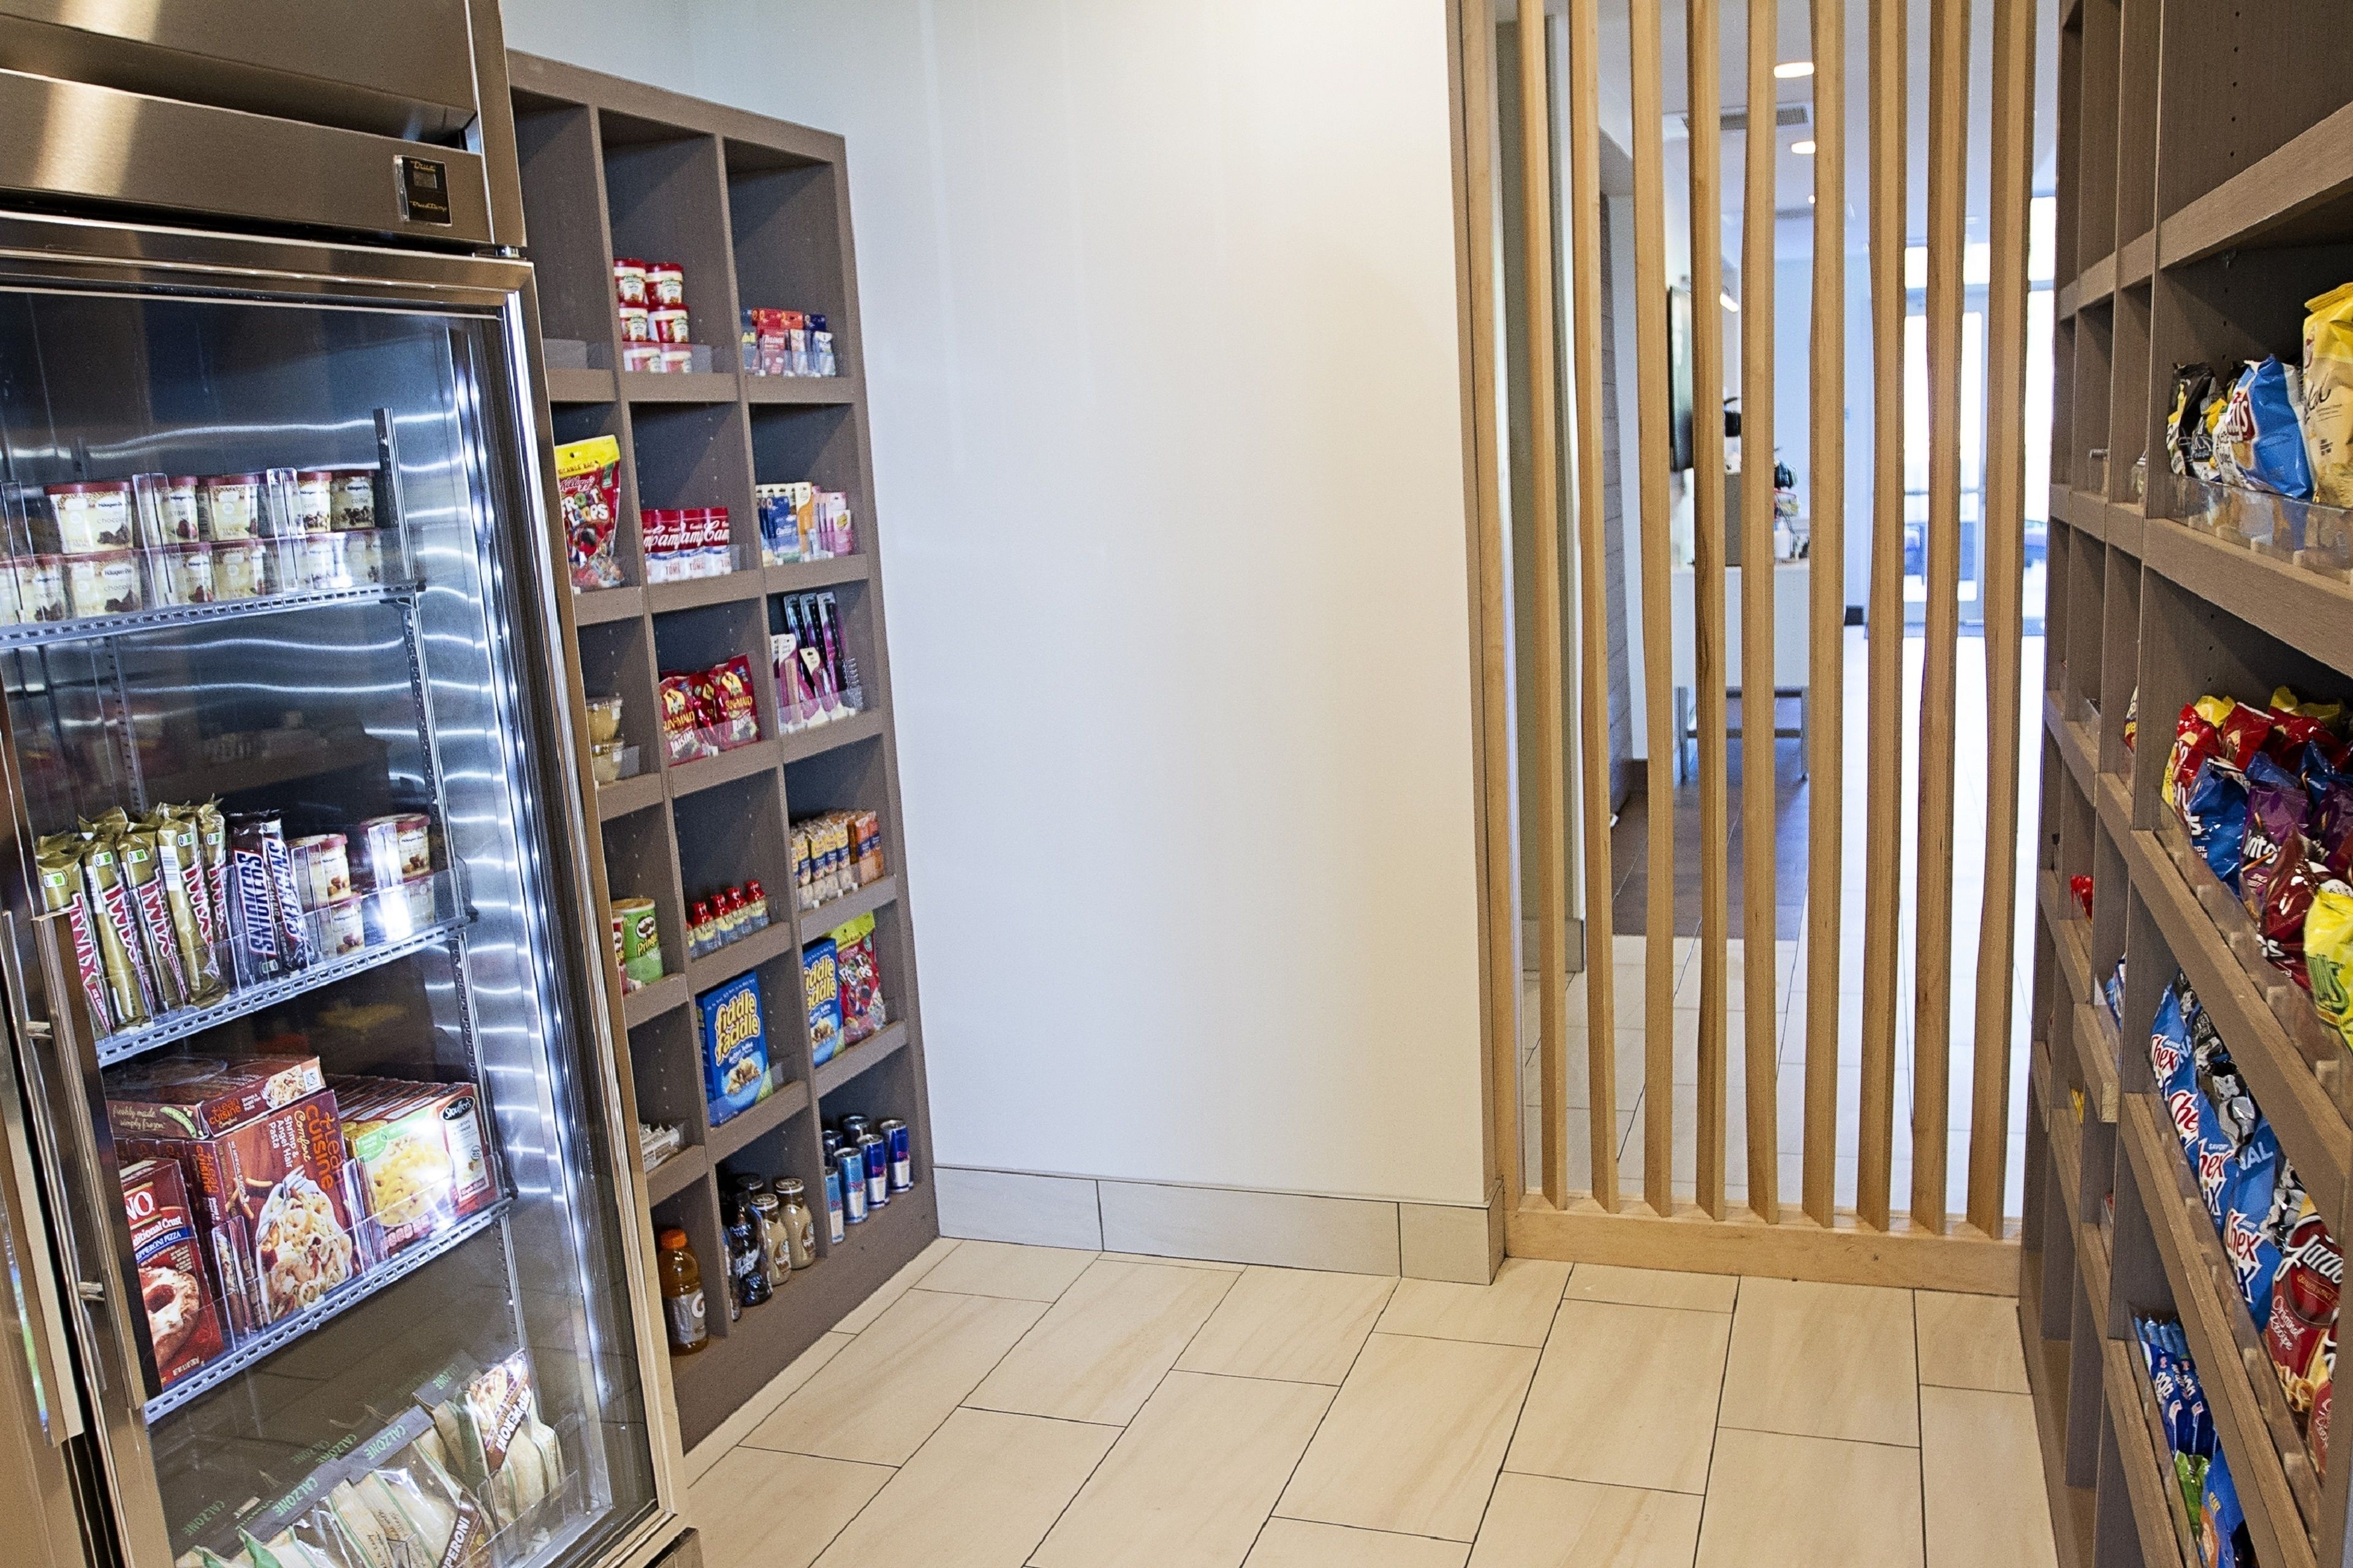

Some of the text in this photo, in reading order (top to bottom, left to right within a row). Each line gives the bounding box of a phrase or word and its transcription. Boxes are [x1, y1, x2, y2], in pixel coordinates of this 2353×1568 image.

[236, 850, 275, 953] SNICKERS
[69, 891, 102, 984] TWIX
[637, 931, 658, 958] Pringl
[803, 958, 835, 991] iddle
[807, 979, 836, 1010] addle
[2150, 1036, 2178, 1072] Chex
[444, 1098, 472, 1121] Stouffer's
[2169, 1092, 2199, 1134] Che
[268, 1123, 281, 1149] Pasta
[276, 1120, 294, 1168] Angel Hair
[284, 1115, 297, 1149] Shrimp
[294, 1110, 312, 1162] Comfort
[2199, 1142, 2232, 1180] hex
[132, 1215, 183, 1246] ditional Crust
[135, 1238, 165, 1261] EPPERONI
[164, 1230, 182, 1243] PIZZA
[2268, 1310, 2294, 1351] Recipe
[2272, 1294, 2305, 1341] Original
[364, 1425, 407, 1461] CALZONE
[273, 1475, 319, 1517] CALZONE
